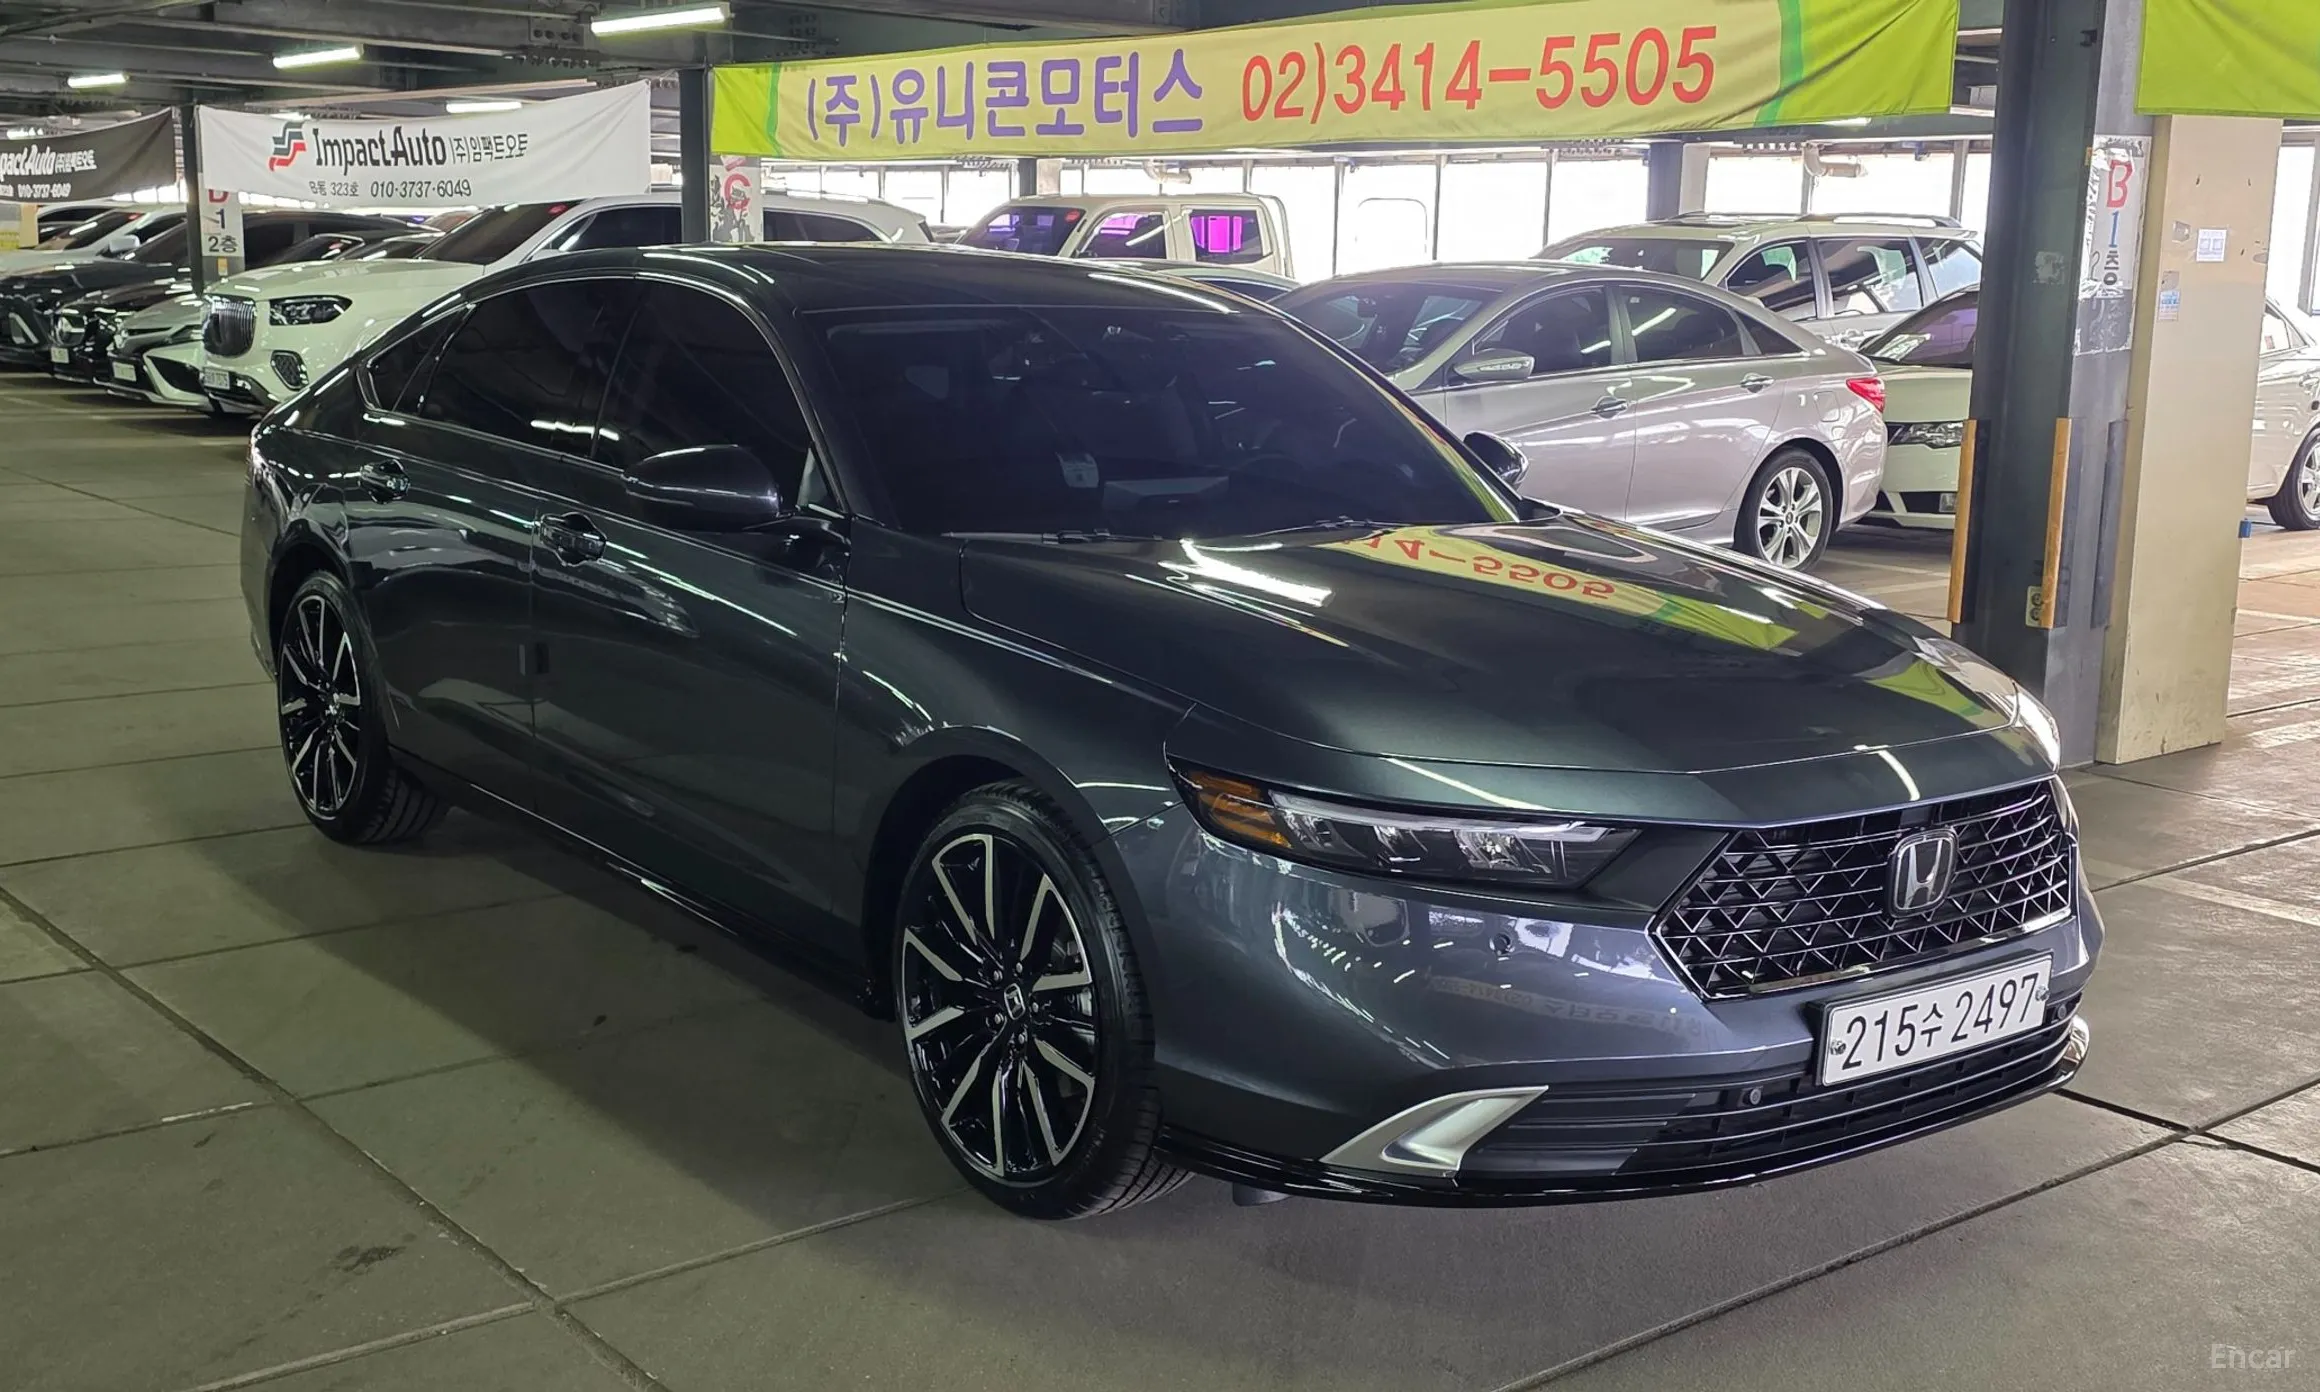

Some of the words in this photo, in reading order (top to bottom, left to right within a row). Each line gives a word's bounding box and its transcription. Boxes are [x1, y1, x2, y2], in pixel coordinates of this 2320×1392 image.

[807, 47, 1204, 147] (주)유니콘모터스
[1241, 25, 1718, 124] 02)3414-5505
[312, 126, 447, 176] ImpactAuto
[2106, 159, 2133, 208] B
[215, 207, 226, 230] 1
[207, 235, 238, 254] 2층
